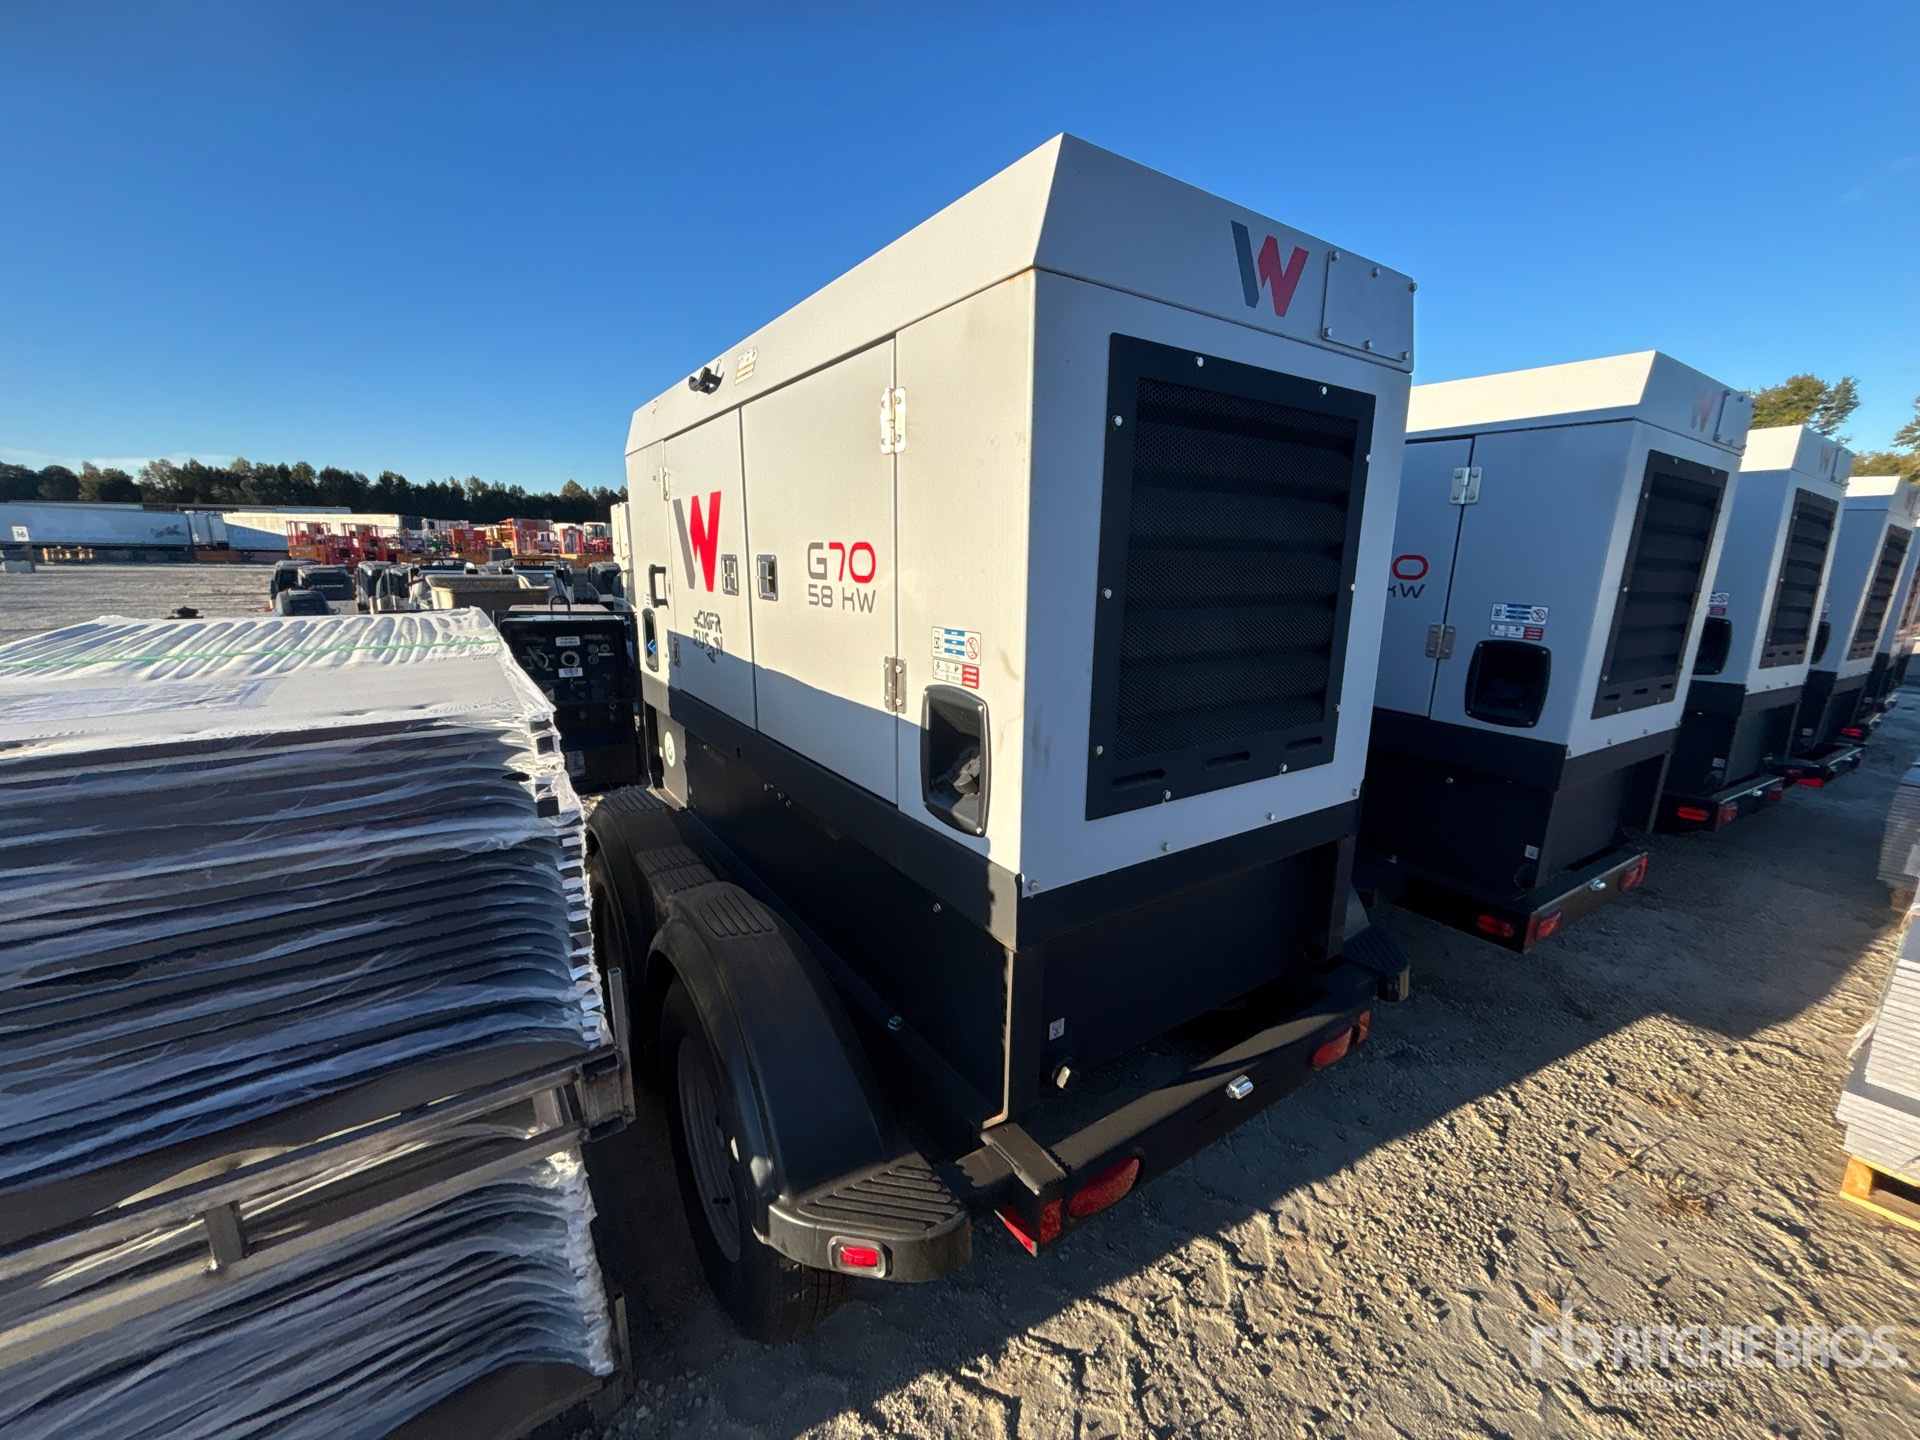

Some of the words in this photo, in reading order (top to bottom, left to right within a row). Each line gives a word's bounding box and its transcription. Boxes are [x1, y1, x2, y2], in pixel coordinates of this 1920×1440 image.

[1231, 220, 1309, 318] W
[15, 530, 27, 538] 16
[672, 490, 722, 593] W
[807, 541, 877, 584] G70
[1391, 554, 1429, 581] 0
[808, 583, 833, 608] 58
